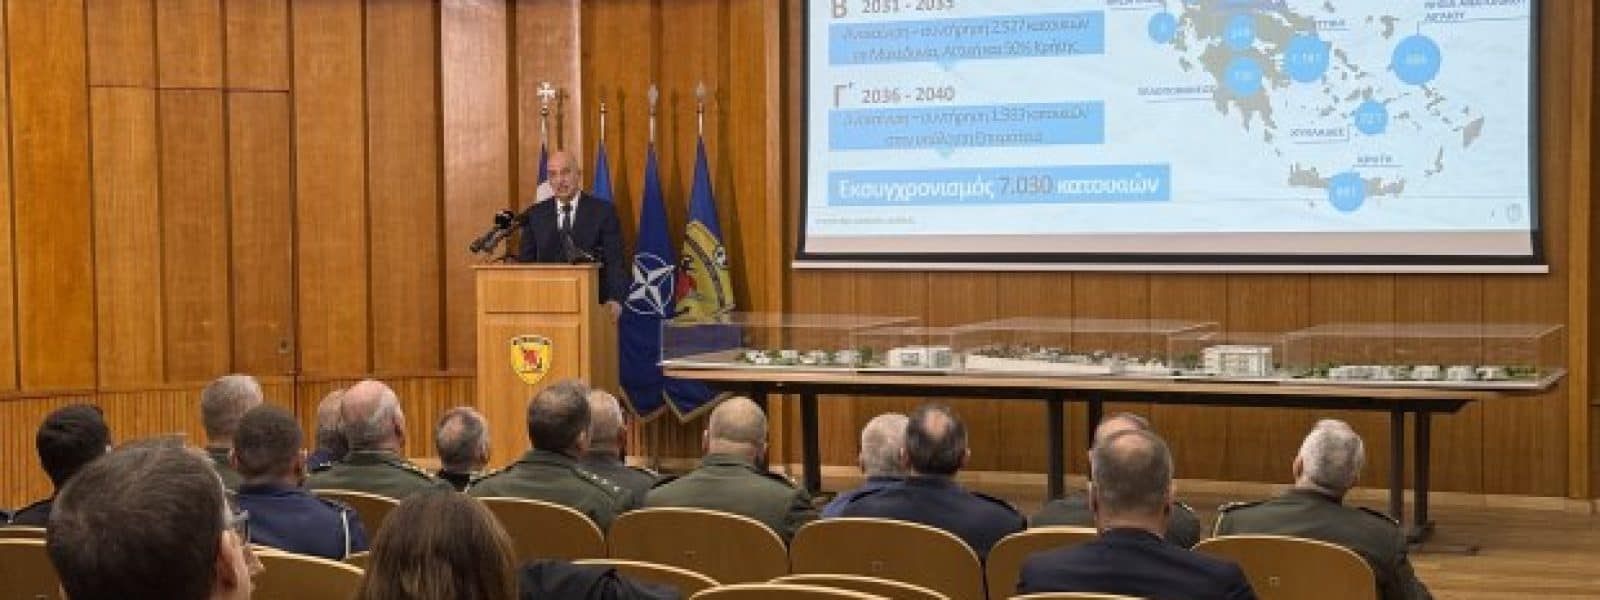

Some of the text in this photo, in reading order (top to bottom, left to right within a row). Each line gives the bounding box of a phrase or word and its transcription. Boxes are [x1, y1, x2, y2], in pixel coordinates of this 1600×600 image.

[862, 89, 900, 103] 2036
[915, 86, 955, 102] 2040
[838, 172, 1158, 201] Εκσυγχρονισμός 7.030 κατοικιών
